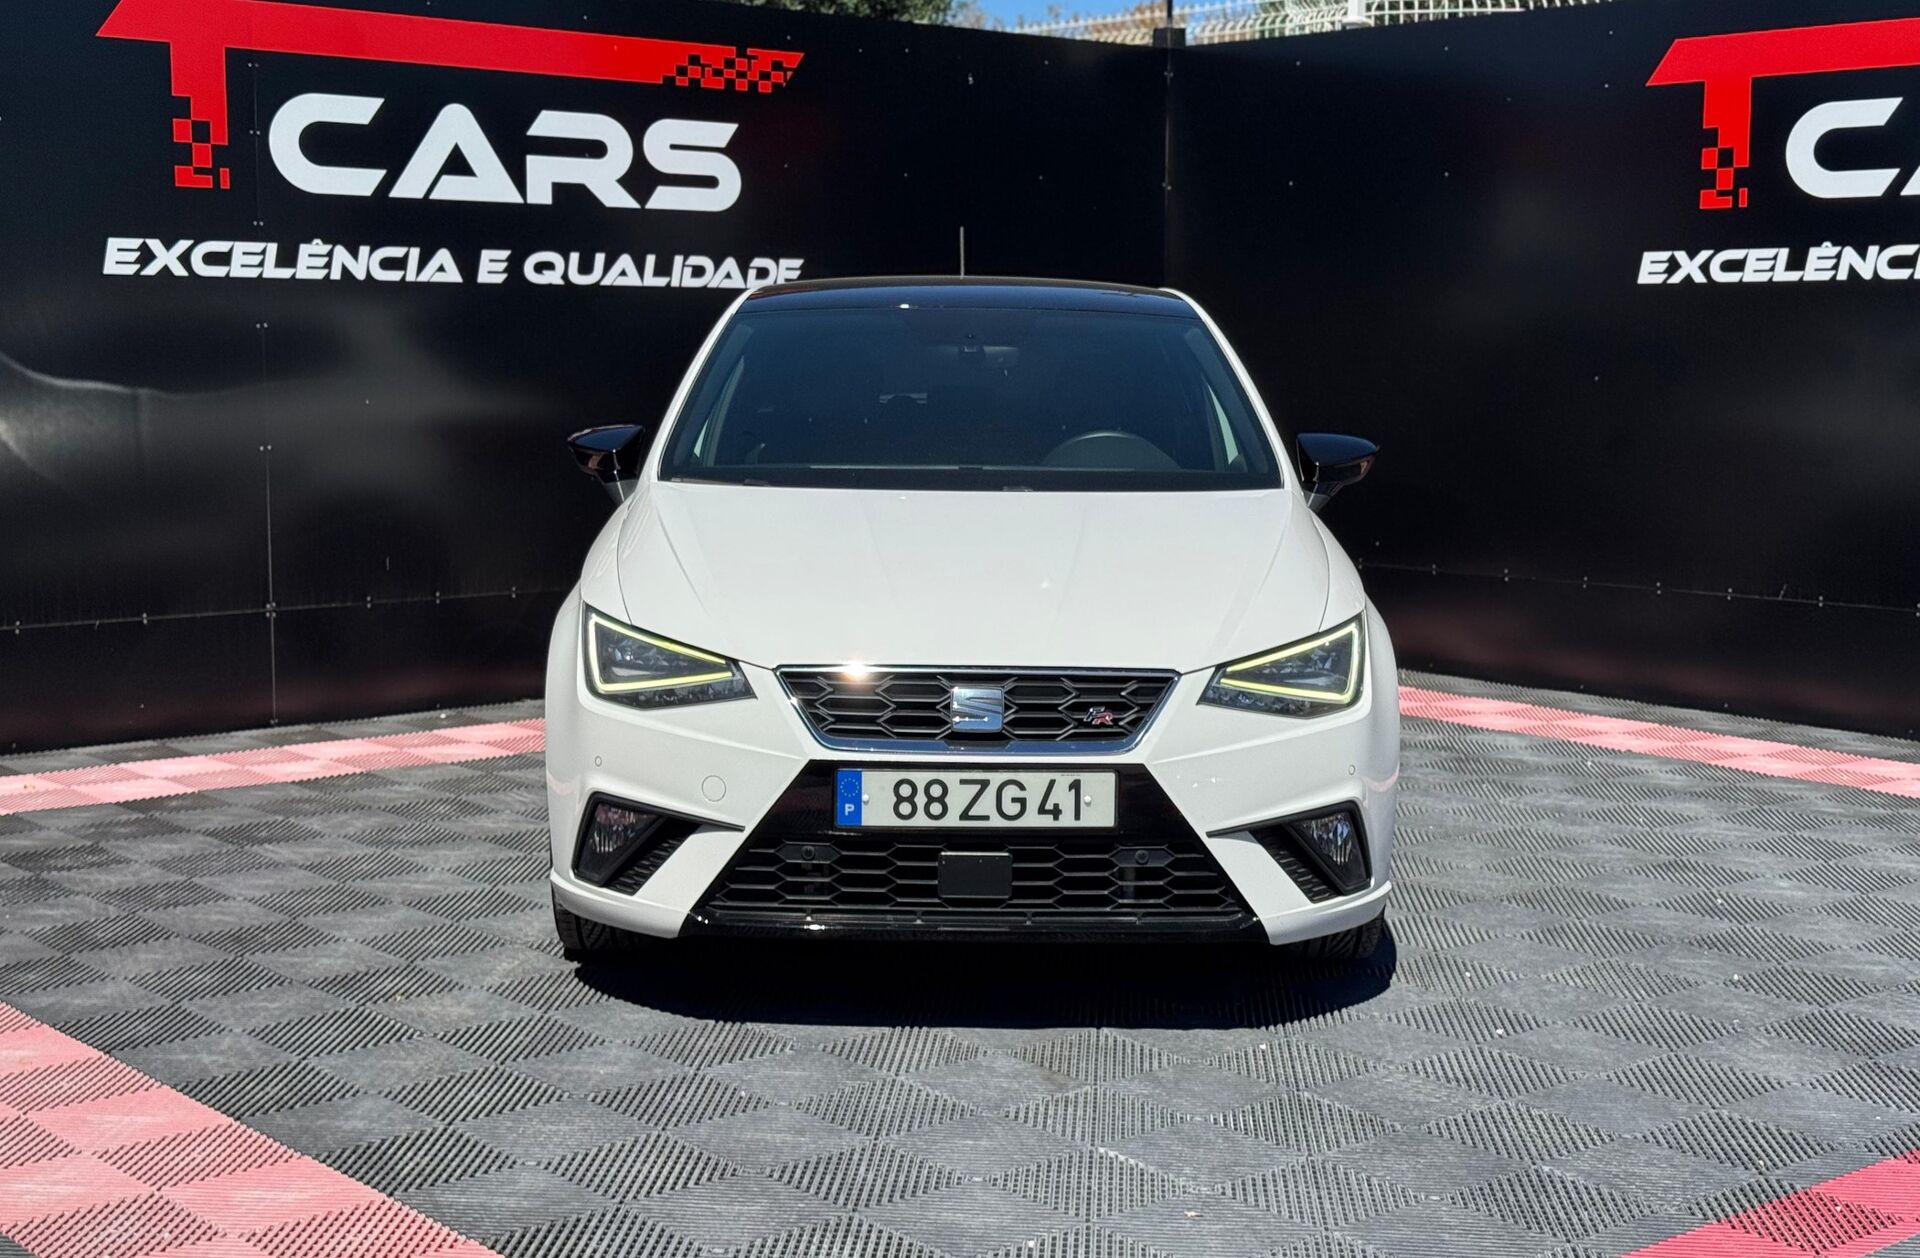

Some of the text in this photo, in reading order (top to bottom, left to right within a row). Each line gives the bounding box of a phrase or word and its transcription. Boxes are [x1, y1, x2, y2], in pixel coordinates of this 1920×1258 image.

[102, 237, 805, 288] EXCELÊNCIA E QUALIDADE
[844, 803, 855, 817] P
